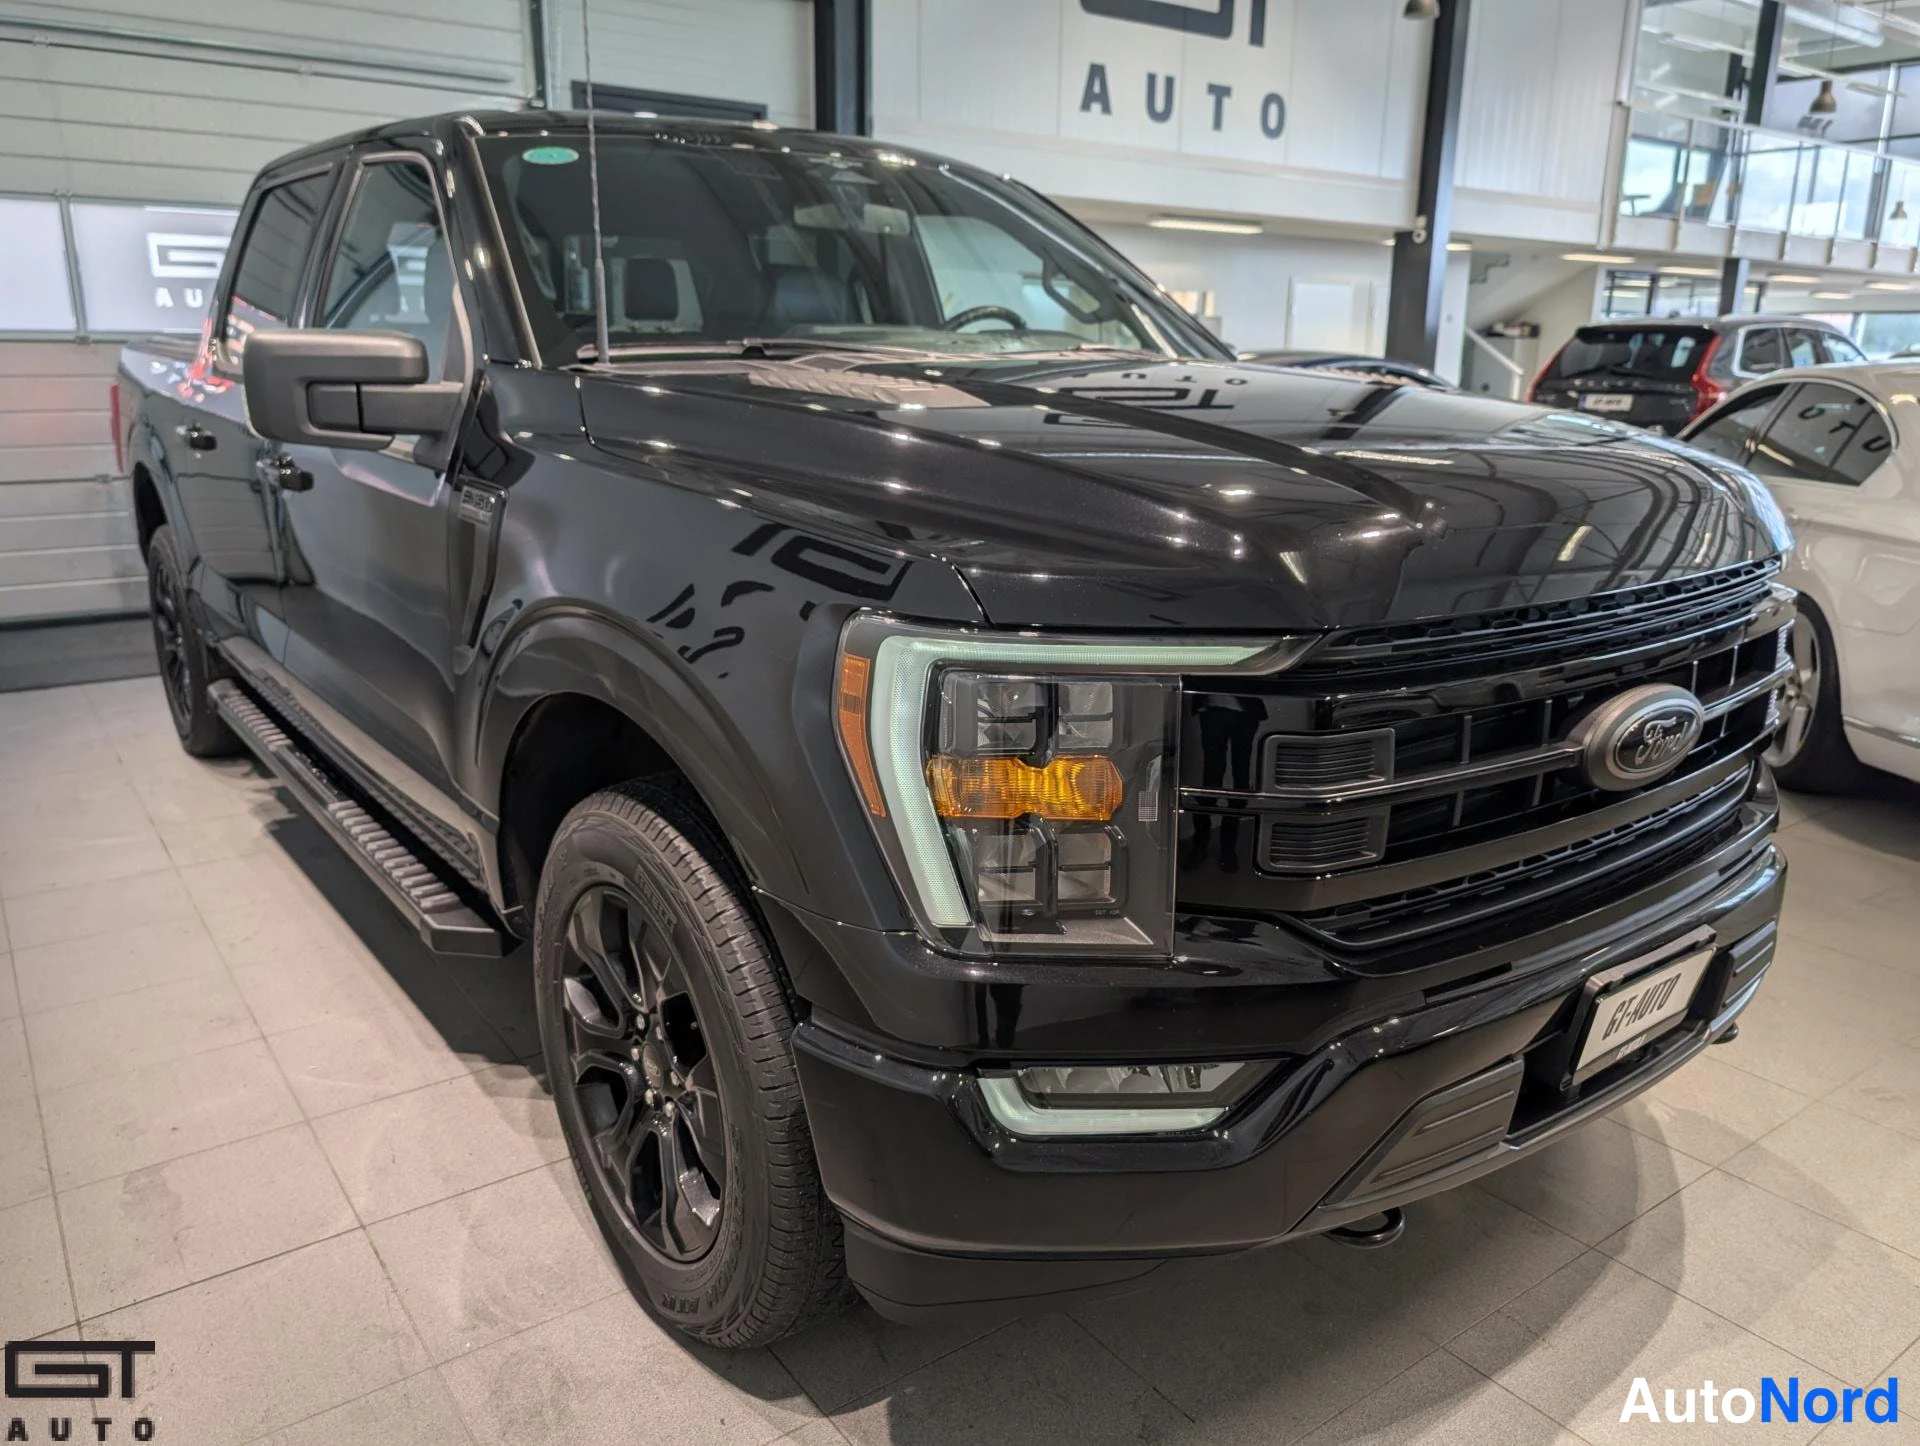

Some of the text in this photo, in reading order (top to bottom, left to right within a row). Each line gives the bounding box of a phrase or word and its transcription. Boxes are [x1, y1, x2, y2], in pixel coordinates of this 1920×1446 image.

[1080, 62, 1286, 139] AUTO
[155, 287, 204, 309] AU
[1635, 716, 1689, 767] Ford
[1602, 973, 1682, 1041] GT-AUTO
